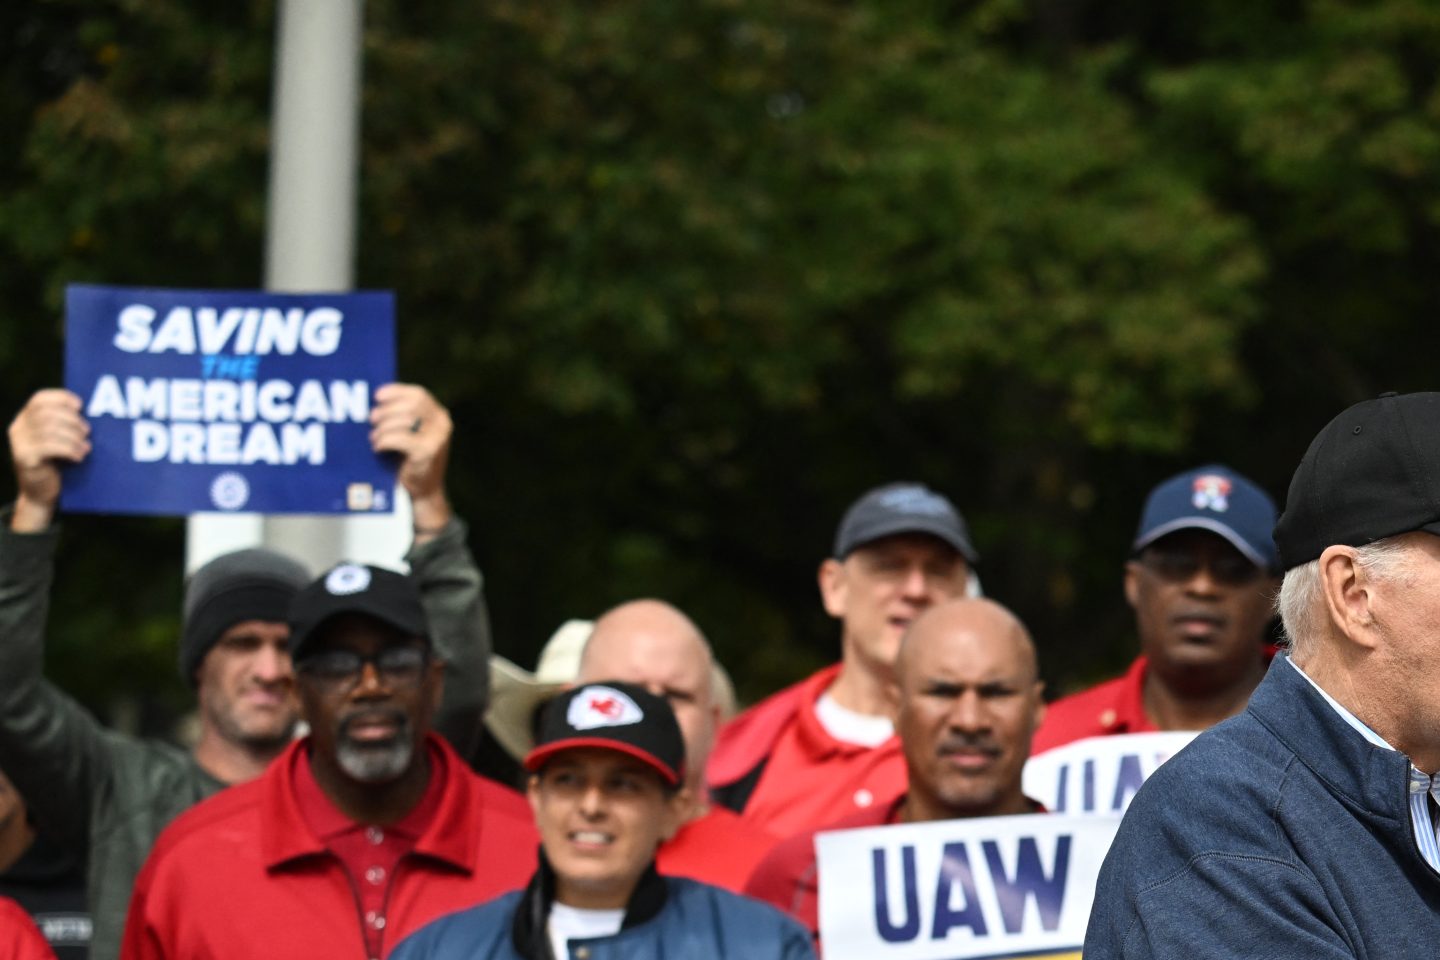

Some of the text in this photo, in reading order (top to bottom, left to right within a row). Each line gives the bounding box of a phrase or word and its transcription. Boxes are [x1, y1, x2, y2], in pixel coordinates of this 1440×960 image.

[113, 304, 343, 356] SAVING
[203, 356, 260, 379] THE
[87, 375, 369, 423] AMERICAN
[132, 421, 326, 465] DREAM
[872, 834, 1072, 944] UAW
